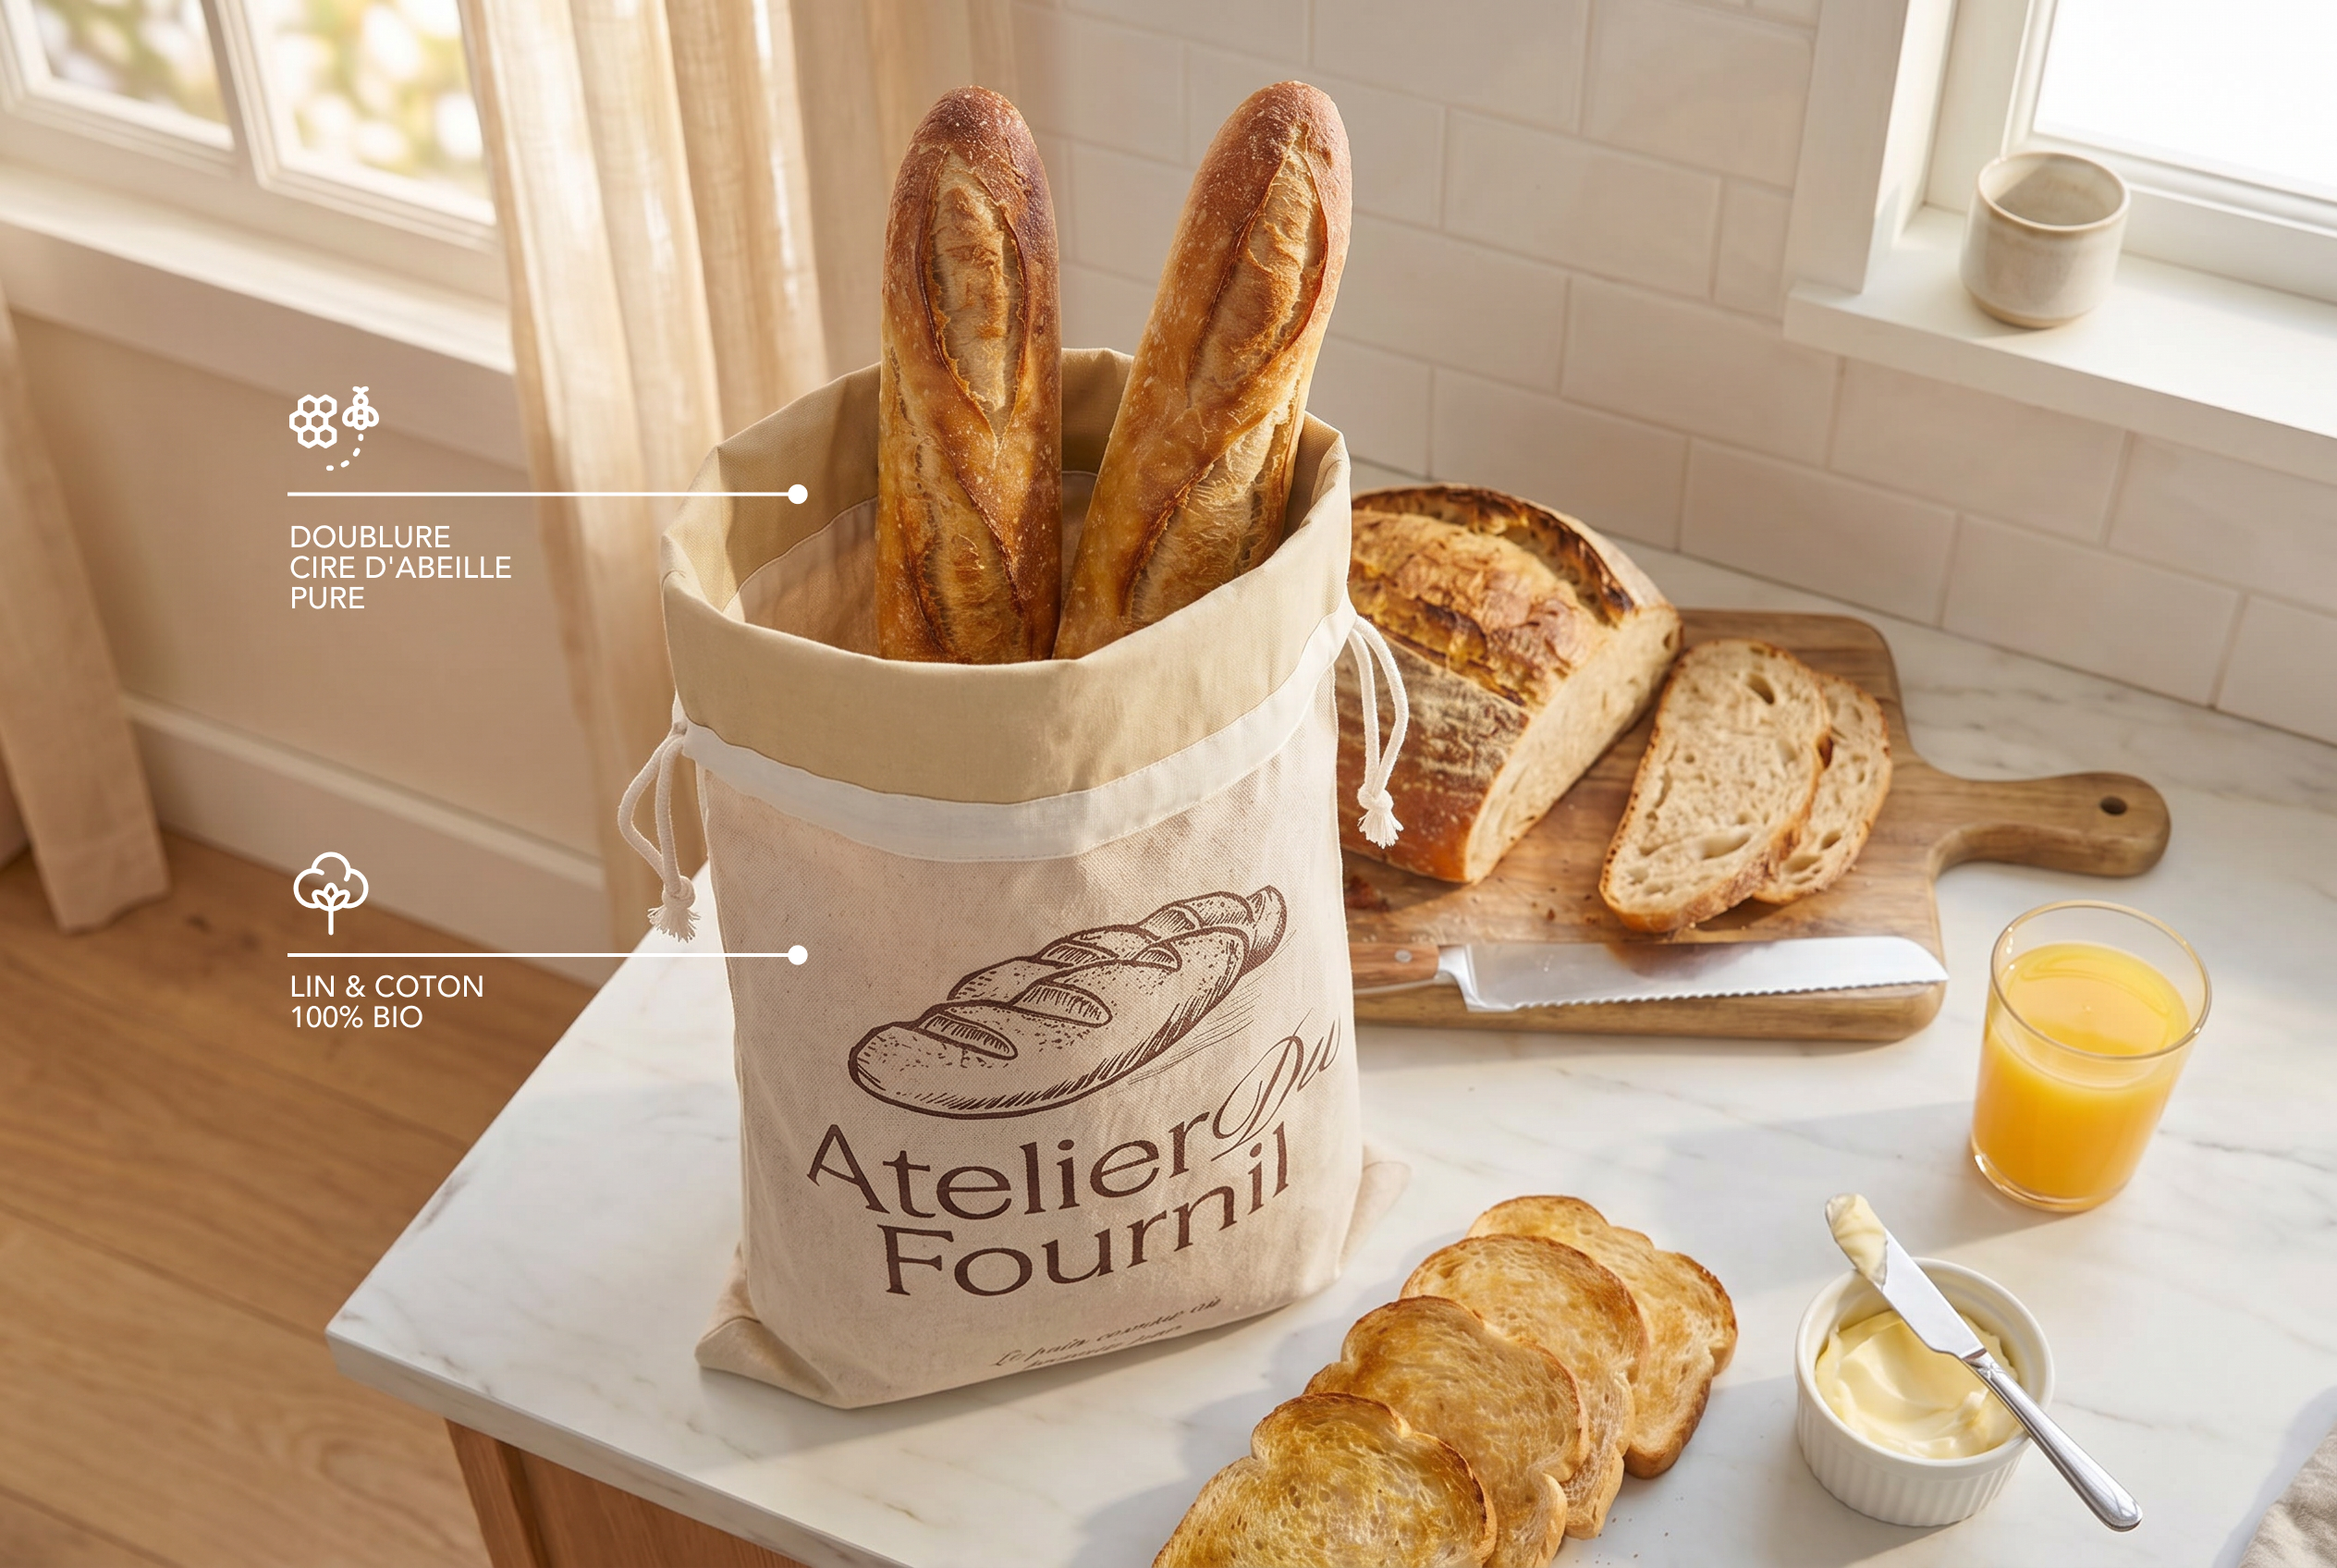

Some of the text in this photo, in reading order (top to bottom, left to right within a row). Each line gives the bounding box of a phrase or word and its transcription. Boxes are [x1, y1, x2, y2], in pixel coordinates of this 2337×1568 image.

[807, 1009, 1342, 1221] Atelier Du
[877, 1121, 1291, 1296] Fournil
